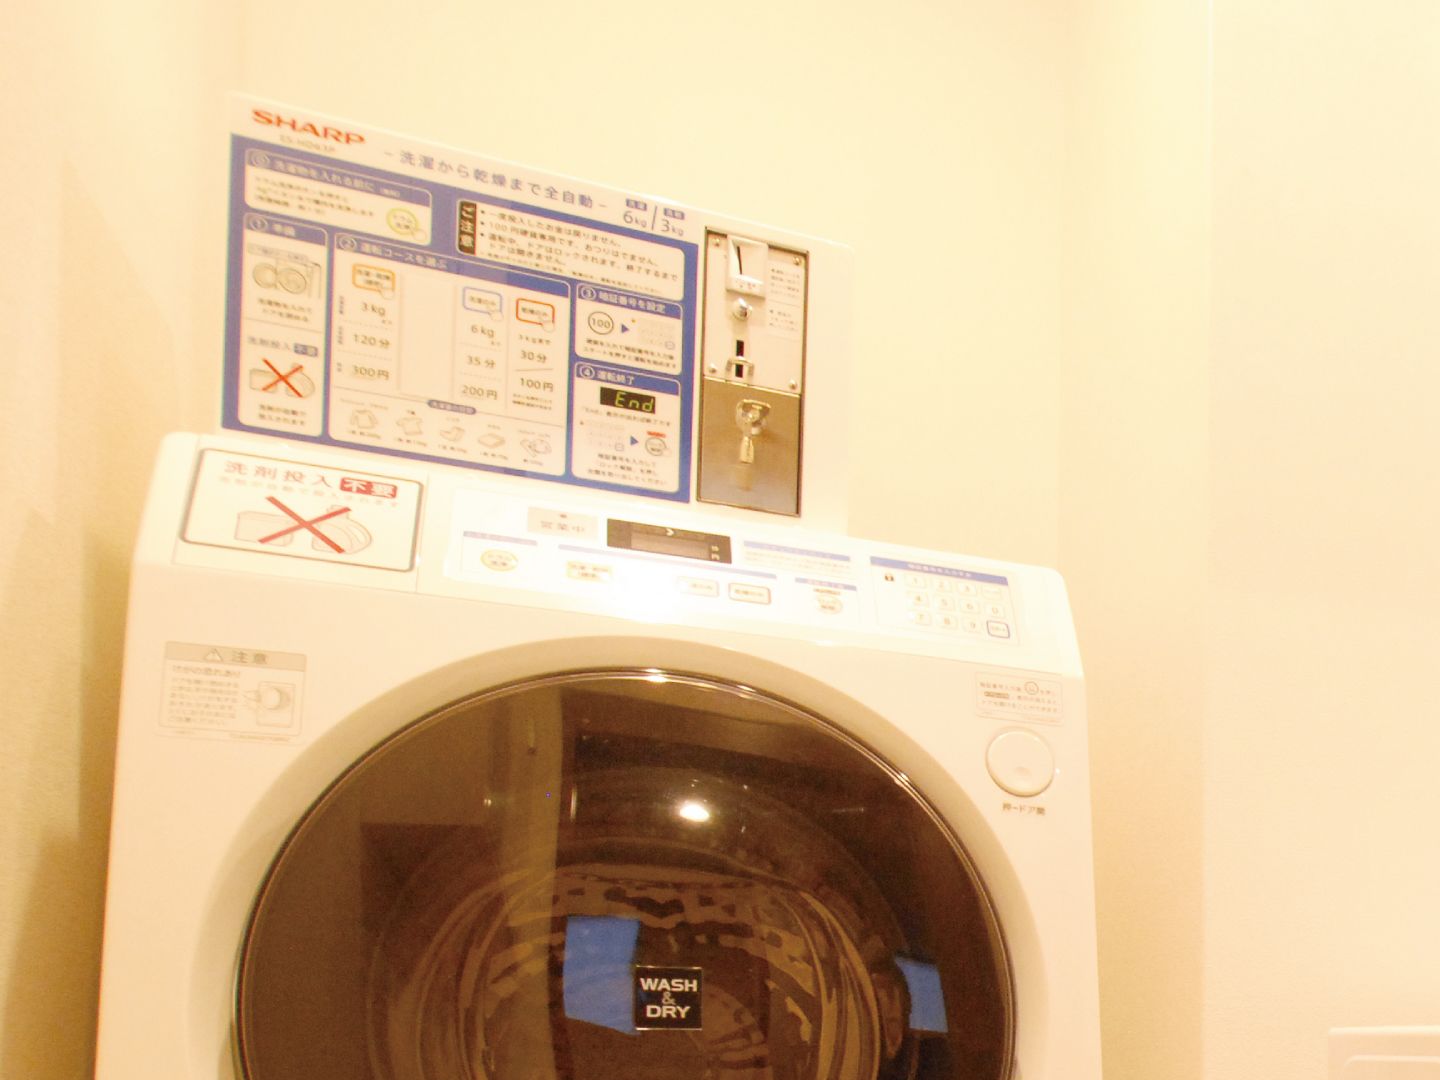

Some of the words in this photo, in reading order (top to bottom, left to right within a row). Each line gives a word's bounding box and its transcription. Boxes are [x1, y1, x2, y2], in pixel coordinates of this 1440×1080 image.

[251, 108, 366, 145] SHARP
[460, 203, 474, 248] ご注意
[622, 210, 648, 229] 6kg
[661, 218, 685, 238] 3kg
[614, 391, 655, 413] End
[224, 460, 335, 489] 洗剤投入
[342, 478, 396, 498] 不要
[639, 977, 698, 993] WASH
[662, 991, 677, 1006] &
[645, 1004, 691, 1019] DRY
